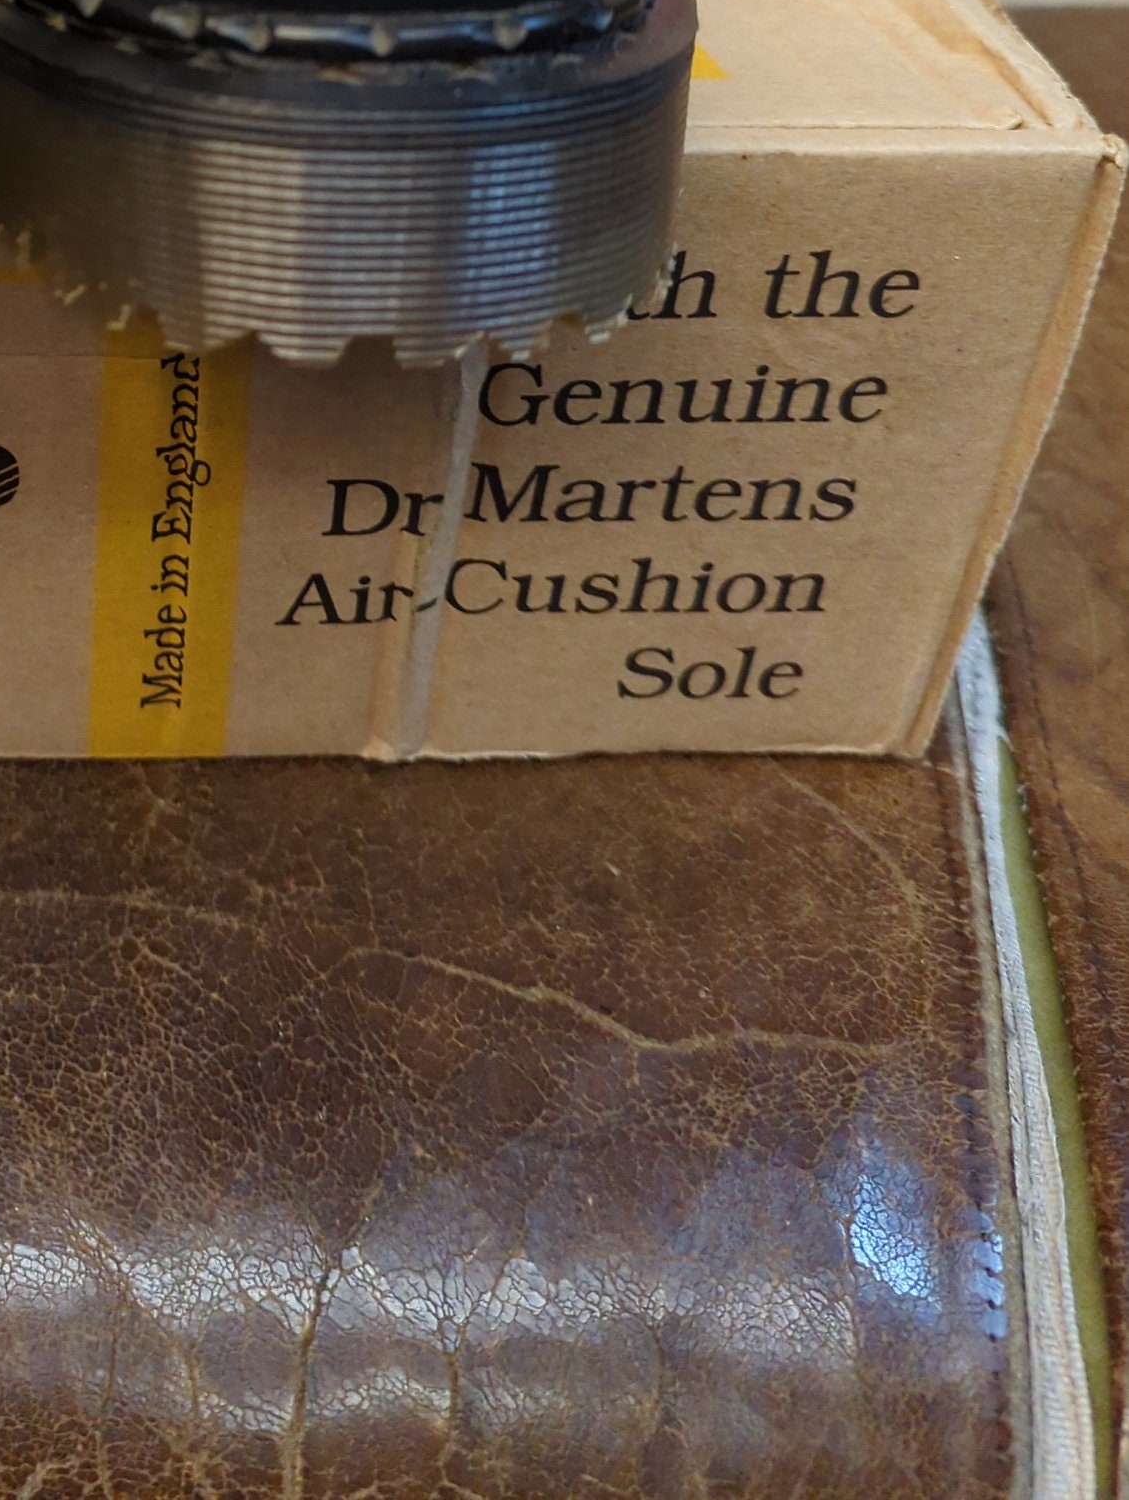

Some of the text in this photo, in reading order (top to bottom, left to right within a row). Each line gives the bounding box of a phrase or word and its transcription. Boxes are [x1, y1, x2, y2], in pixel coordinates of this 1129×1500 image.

[765, 250, 920, 319] the
[477, 362, 888, 426] Genuine
[139, 352, 212, 709] Made in England
[321, 461, 857, 537] Dr Martens
[617, 646, 804, 700] Sole
